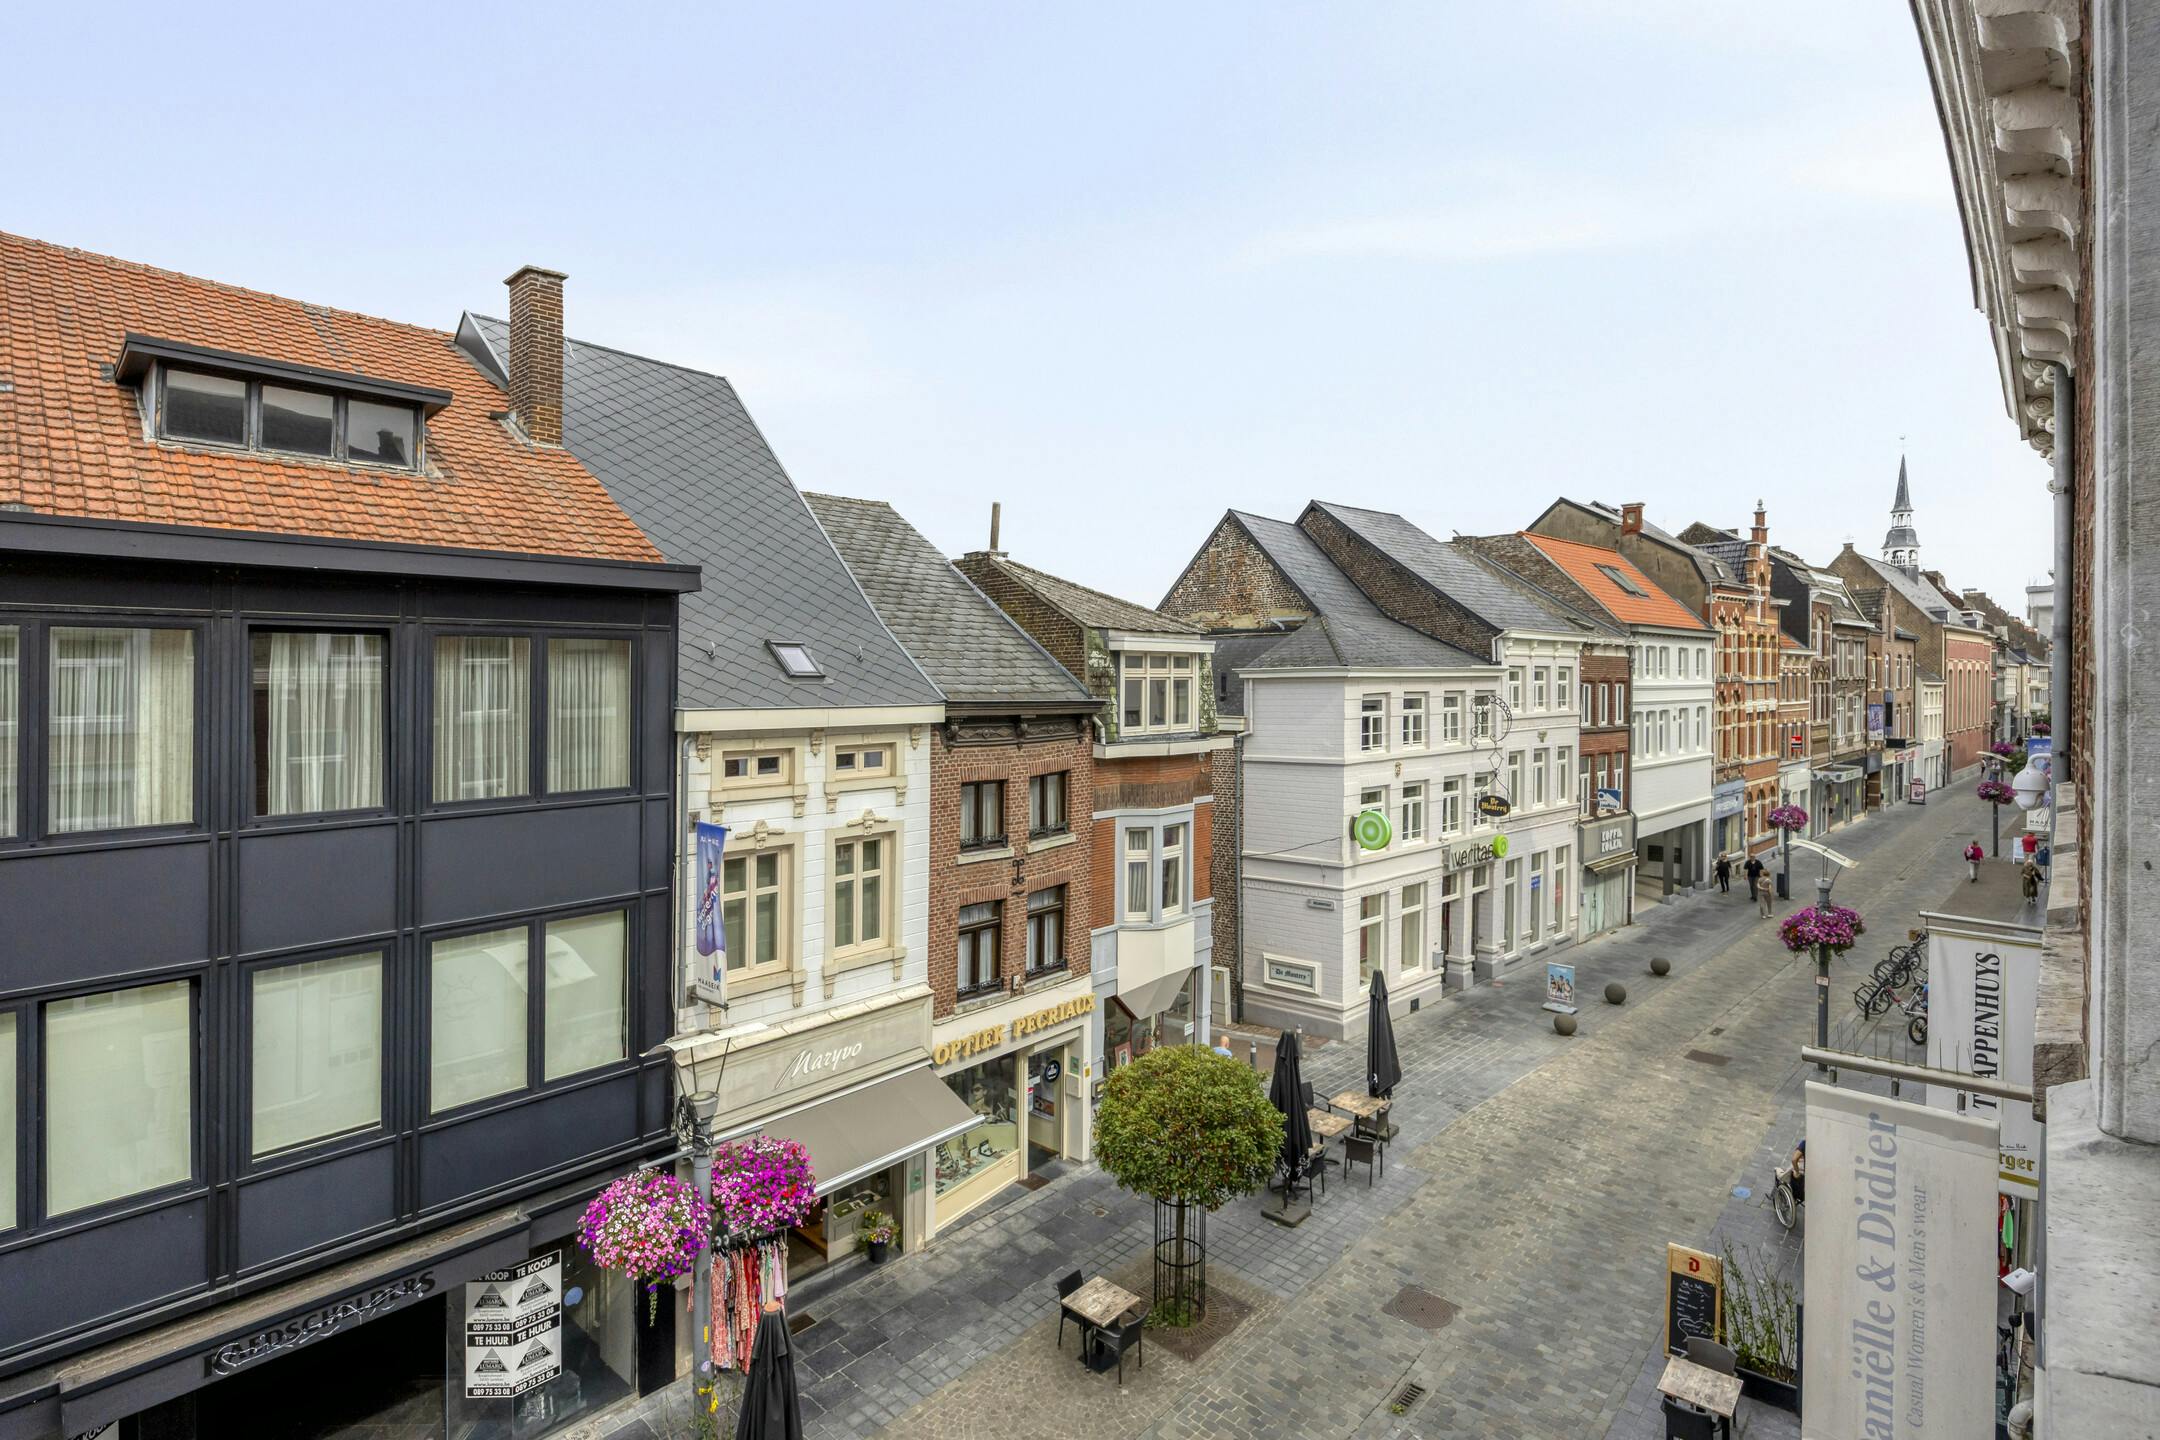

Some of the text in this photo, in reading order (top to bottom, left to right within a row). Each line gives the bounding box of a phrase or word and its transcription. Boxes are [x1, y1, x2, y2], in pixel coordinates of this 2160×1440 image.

[1454, 843, 1494, 867] veritas
[933, 1023, 1006, 1065] OPTIEK
[775, 1042, 863, 1089] Maryvo
[2000, 1152, 2035, 1172] rger
[516, 1256, 553, 1278] TE KOOP
[1852, 1112, 1898, 1440] aniëlle & Didier
[515, 1306, 555, 1328] 089 75 33 08
[1906, 1185, 1927, 1428] Casual Women's & Men's wear
[475, 1336, 509, 1345] TE HUUR
[517, 1320, 552, 1342] TE HUUR
[473, 1388, 510, 1396] 089 75 33 08
[515, 1370, 555, 1393] 089 75 33 08
